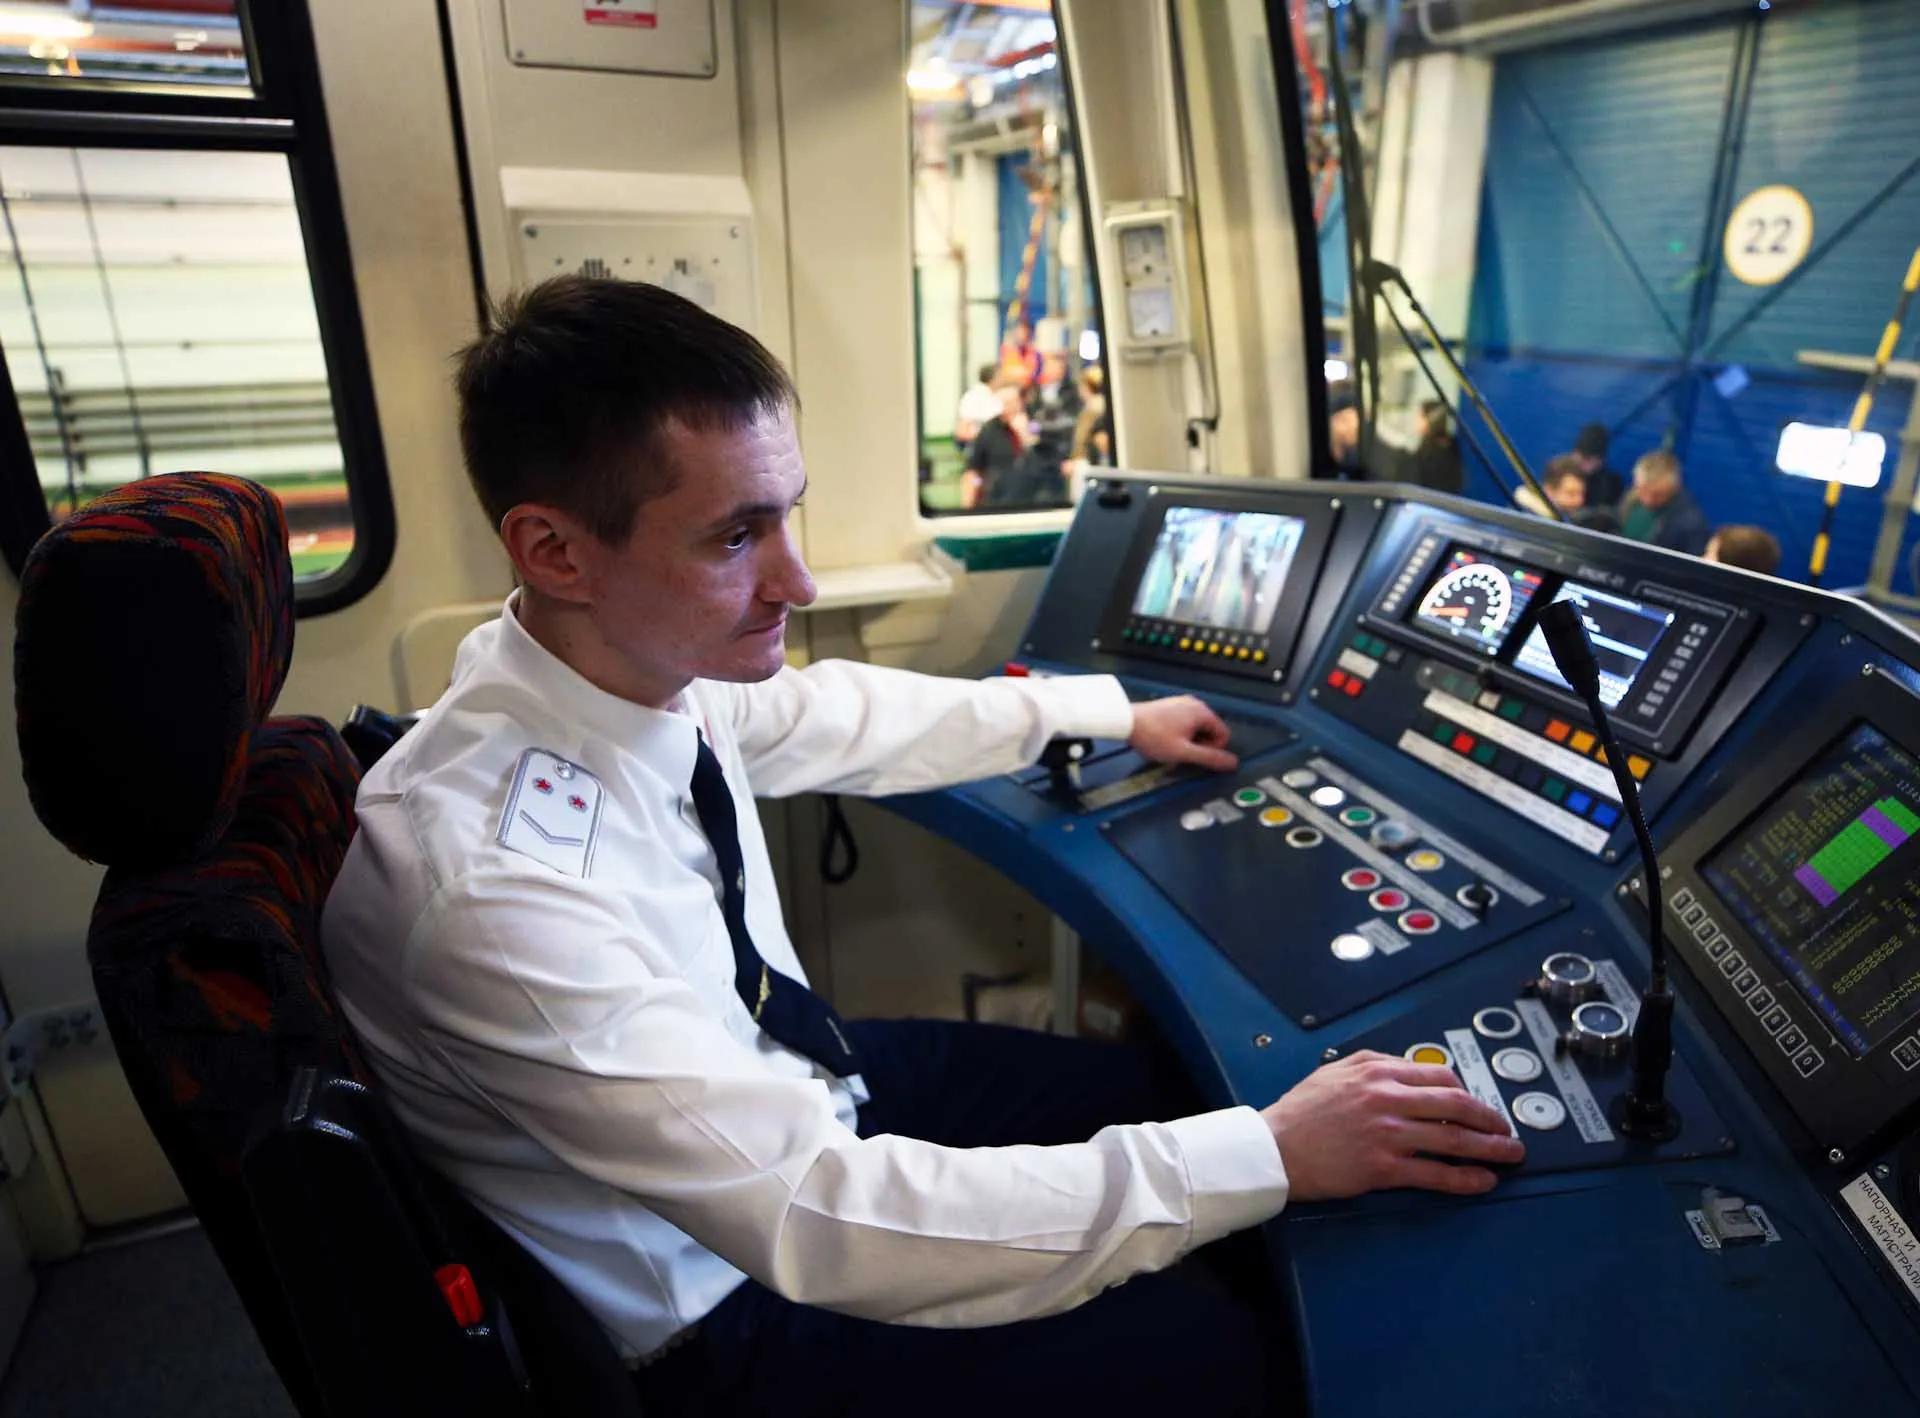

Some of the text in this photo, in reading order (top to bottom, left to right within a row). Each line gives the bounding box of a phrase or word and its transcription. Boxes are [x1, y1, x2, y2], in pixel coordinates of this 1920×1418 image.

[1744, 215, 1792, 254] 22
[1858, 1179, 1916, 1252] НАПОРНАЯ И
